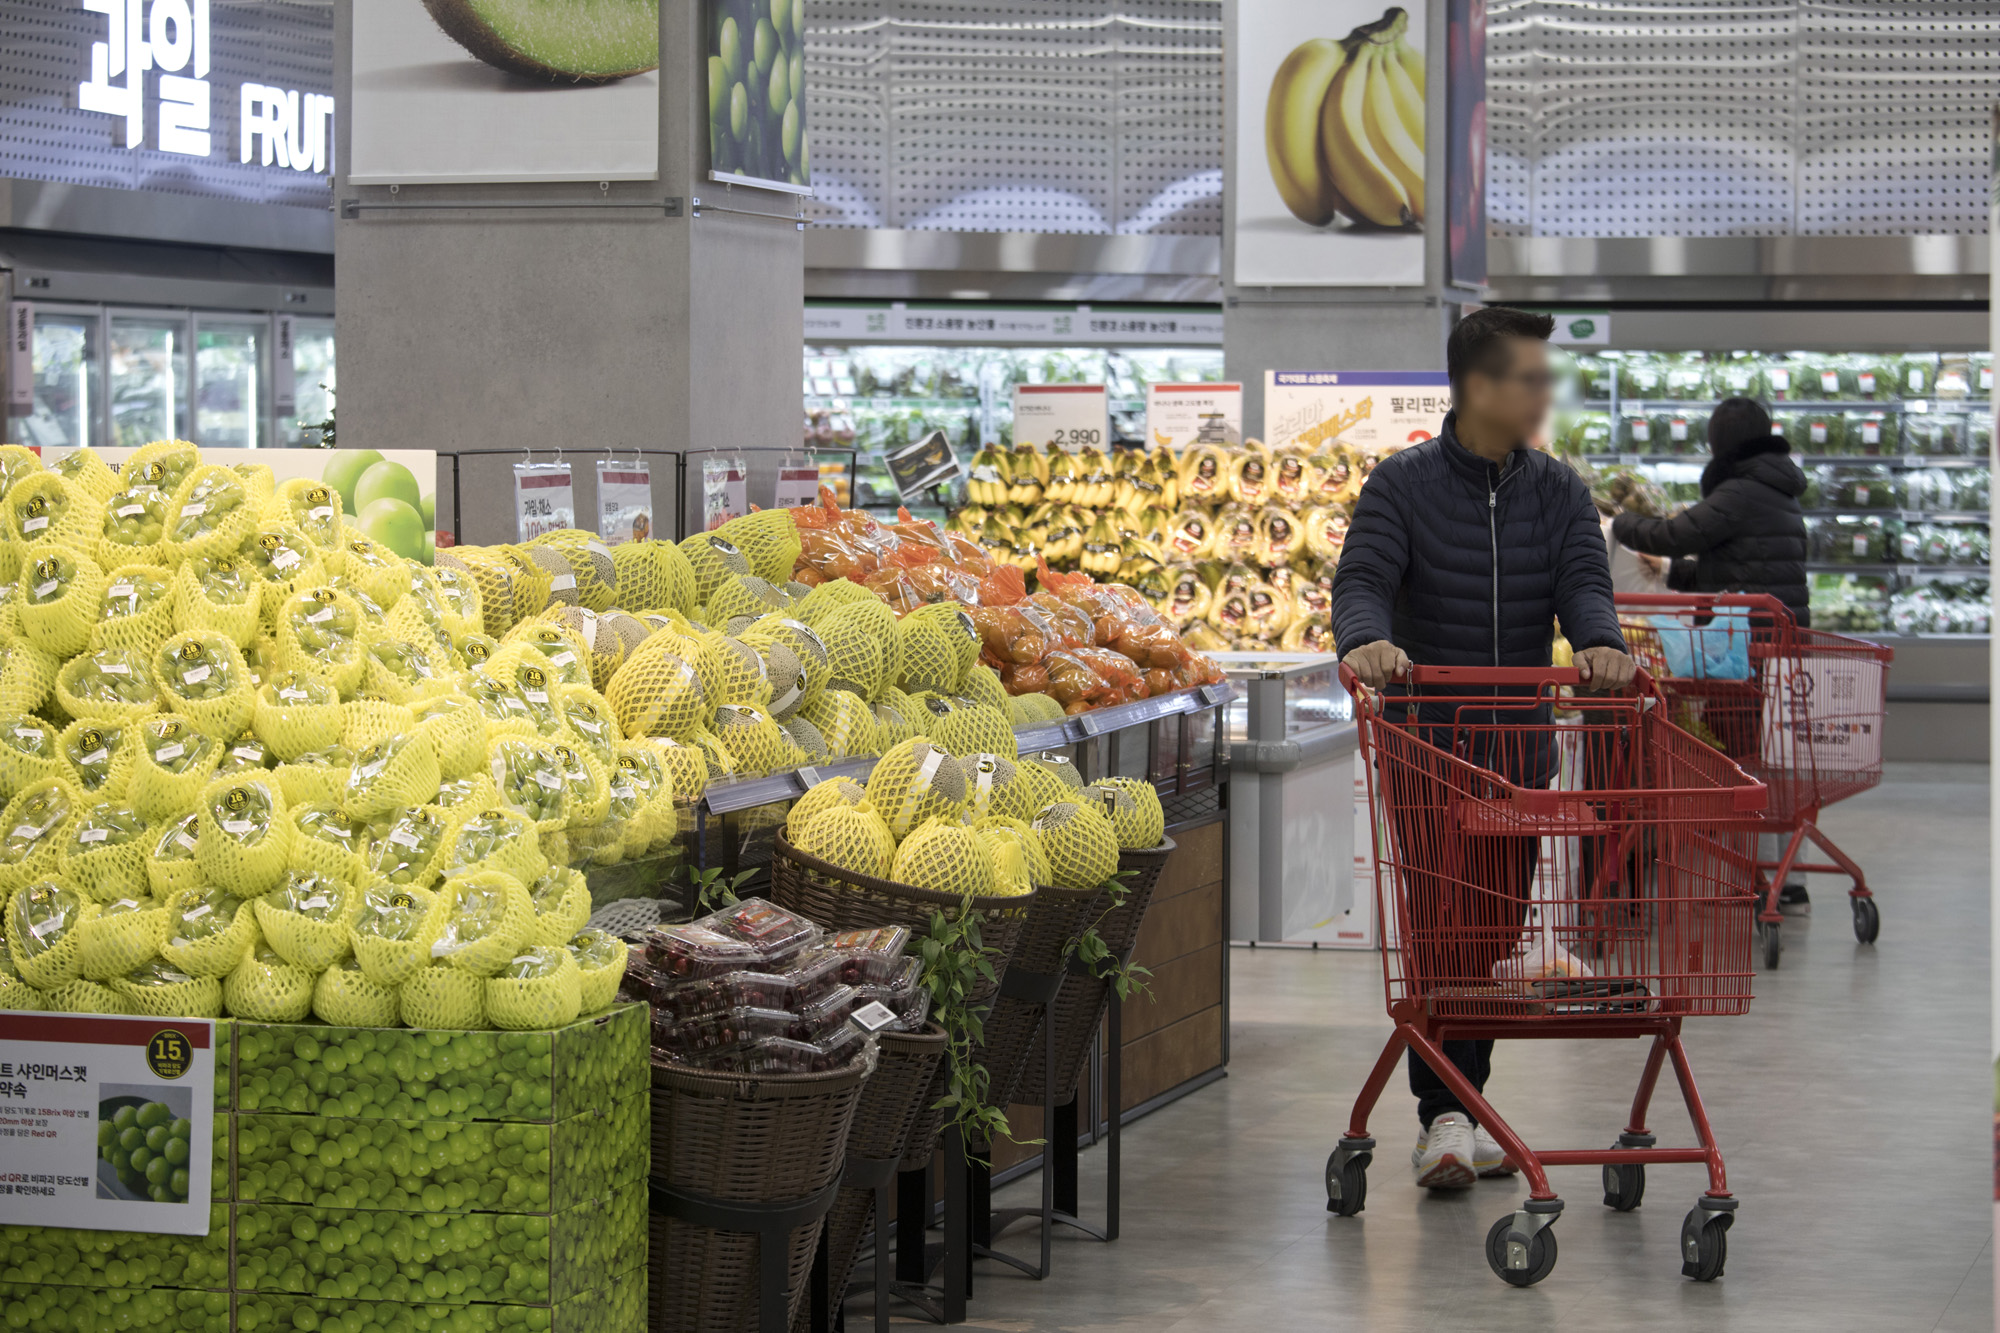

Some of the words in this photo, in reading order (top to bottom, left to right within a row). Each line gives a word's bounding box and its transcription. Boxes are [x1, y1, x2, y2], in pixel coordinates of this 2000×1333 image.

[79, 0, 210, 157] 과일
[1055, 429, 1100, 446] 2,990
[31, 500, 41, 512] 16
[186, 644, 197, 653] 16
[531, 671, 541, 681] 16
[85, 734, 97, 745] 16
[620, 760, 632, 768] 16
[230, 792, 243, 803] 16
[155, 1040, 181, 1060] 15
[17, 1063, 87, 1083] 샤인머스캣
[0, 1081, 27, 1099] 약속
[63, 1110, 75, 1118] 이상
[77, 1110, 89, 1118] 선별
[21, 1118, 34, 1127] 이상
[35, 1119, 48, 1127] 보장
[32, 1130, 45, 1138] Red
[8, 1174, 29, 1183] QR로
[31, 1174, 55, 1184] 비파괴
[57, 1175, 89, 1186] 당도선별
[15, 1185, 55, 1196] 확인하세요
